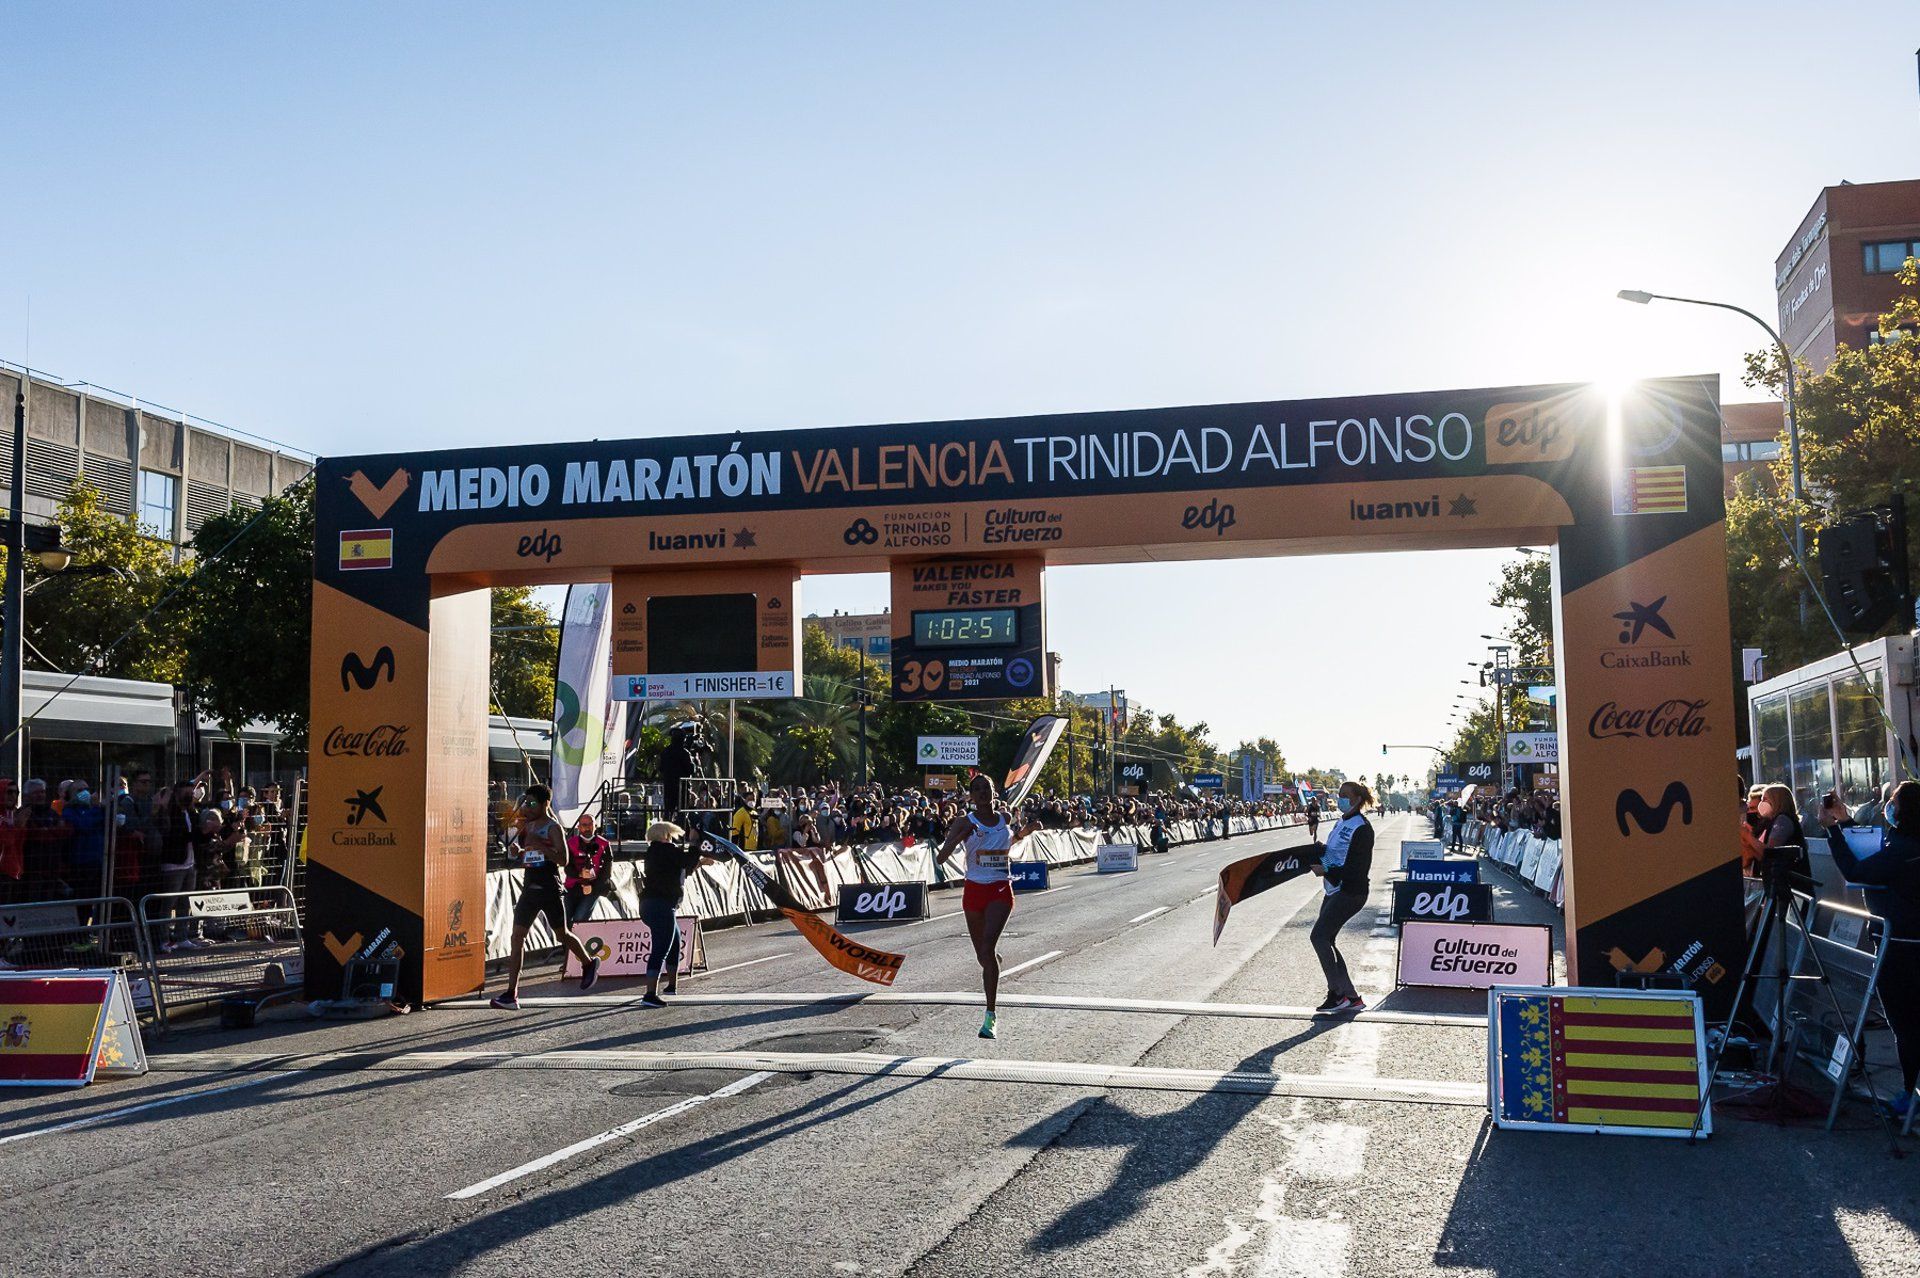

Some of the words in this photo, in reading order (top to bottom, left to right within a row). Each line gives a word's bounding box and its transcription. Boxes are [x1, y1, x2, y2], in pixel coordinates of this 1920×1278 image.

[418, 463, 550, 512] MEDIO
[561, 441, 782, 505] MARATÓN
[792, 439, 1015, 493] VALENCIA
[1013, 427, 1233, 483] TRINIDAD
[1241, 411, 1473, 471] ALFONSO
[1495, 406, 1561, 456] edp
[884, 511, 951, 522] FUNDACIÓN
[983, 508, 1047, 526] Cultura
[1047, 512, 1062, 523] del
[1181, 497, 1236, 536] edp
[1350, 495, 1440, 522] luanvi
[884, 522, 951, 535] TRINIDAD
[983, 524, 1063, 544] Esfuerzo
[517, 528, 562, 563] edp
[649, 528, 726, 551] luanvi
[884, 534, 951, 548] ALFONSO
[912, 563, 1015, 582] VALENCIA
[912, 583, 947, 592] MAKES
[951, 582, 972, 590] YOU
[947, 589, 1021, 605] FASTER
[928, 617, 1011, 640] 1:02:51
[949, 659, 969, 667] MEDIO
[970, 657, 1003, 666] MARATÓN
[1600, 650, 1691, 669] CaixaBank
[683, 680, 689, 693] 1
[964, 678, 979, 686] 2021
[648, 689, 675, 698] sospital
[1588, 700, 1712, 739] Coca-Cola
[323, 725, 410, 757] Coca-Cola
[940, 753, 976, 761] ALFONSO
[1123, 763, 1144, 779] edp
[1468, 762, 1492, 779] edp
[331, 831, 397, 846] CaixaBank
[1411, 870, 1456, 883] luanvi
[854, 885, 907, 919] edp
[1411, 886, 1470, 920] edp
[363, 927, 391, 958] MARATÓN
[443, 931, 467, 949] AIMS
[1433, 938, 1501, 957] Cultura
[1502, 947, 1518, 957] del
[1430, 955, 1518, 975] Esfuerzo
[1672, 940, 1704, 974] ARATÓN
[1688, 956, 1715, 982] LFONSO
